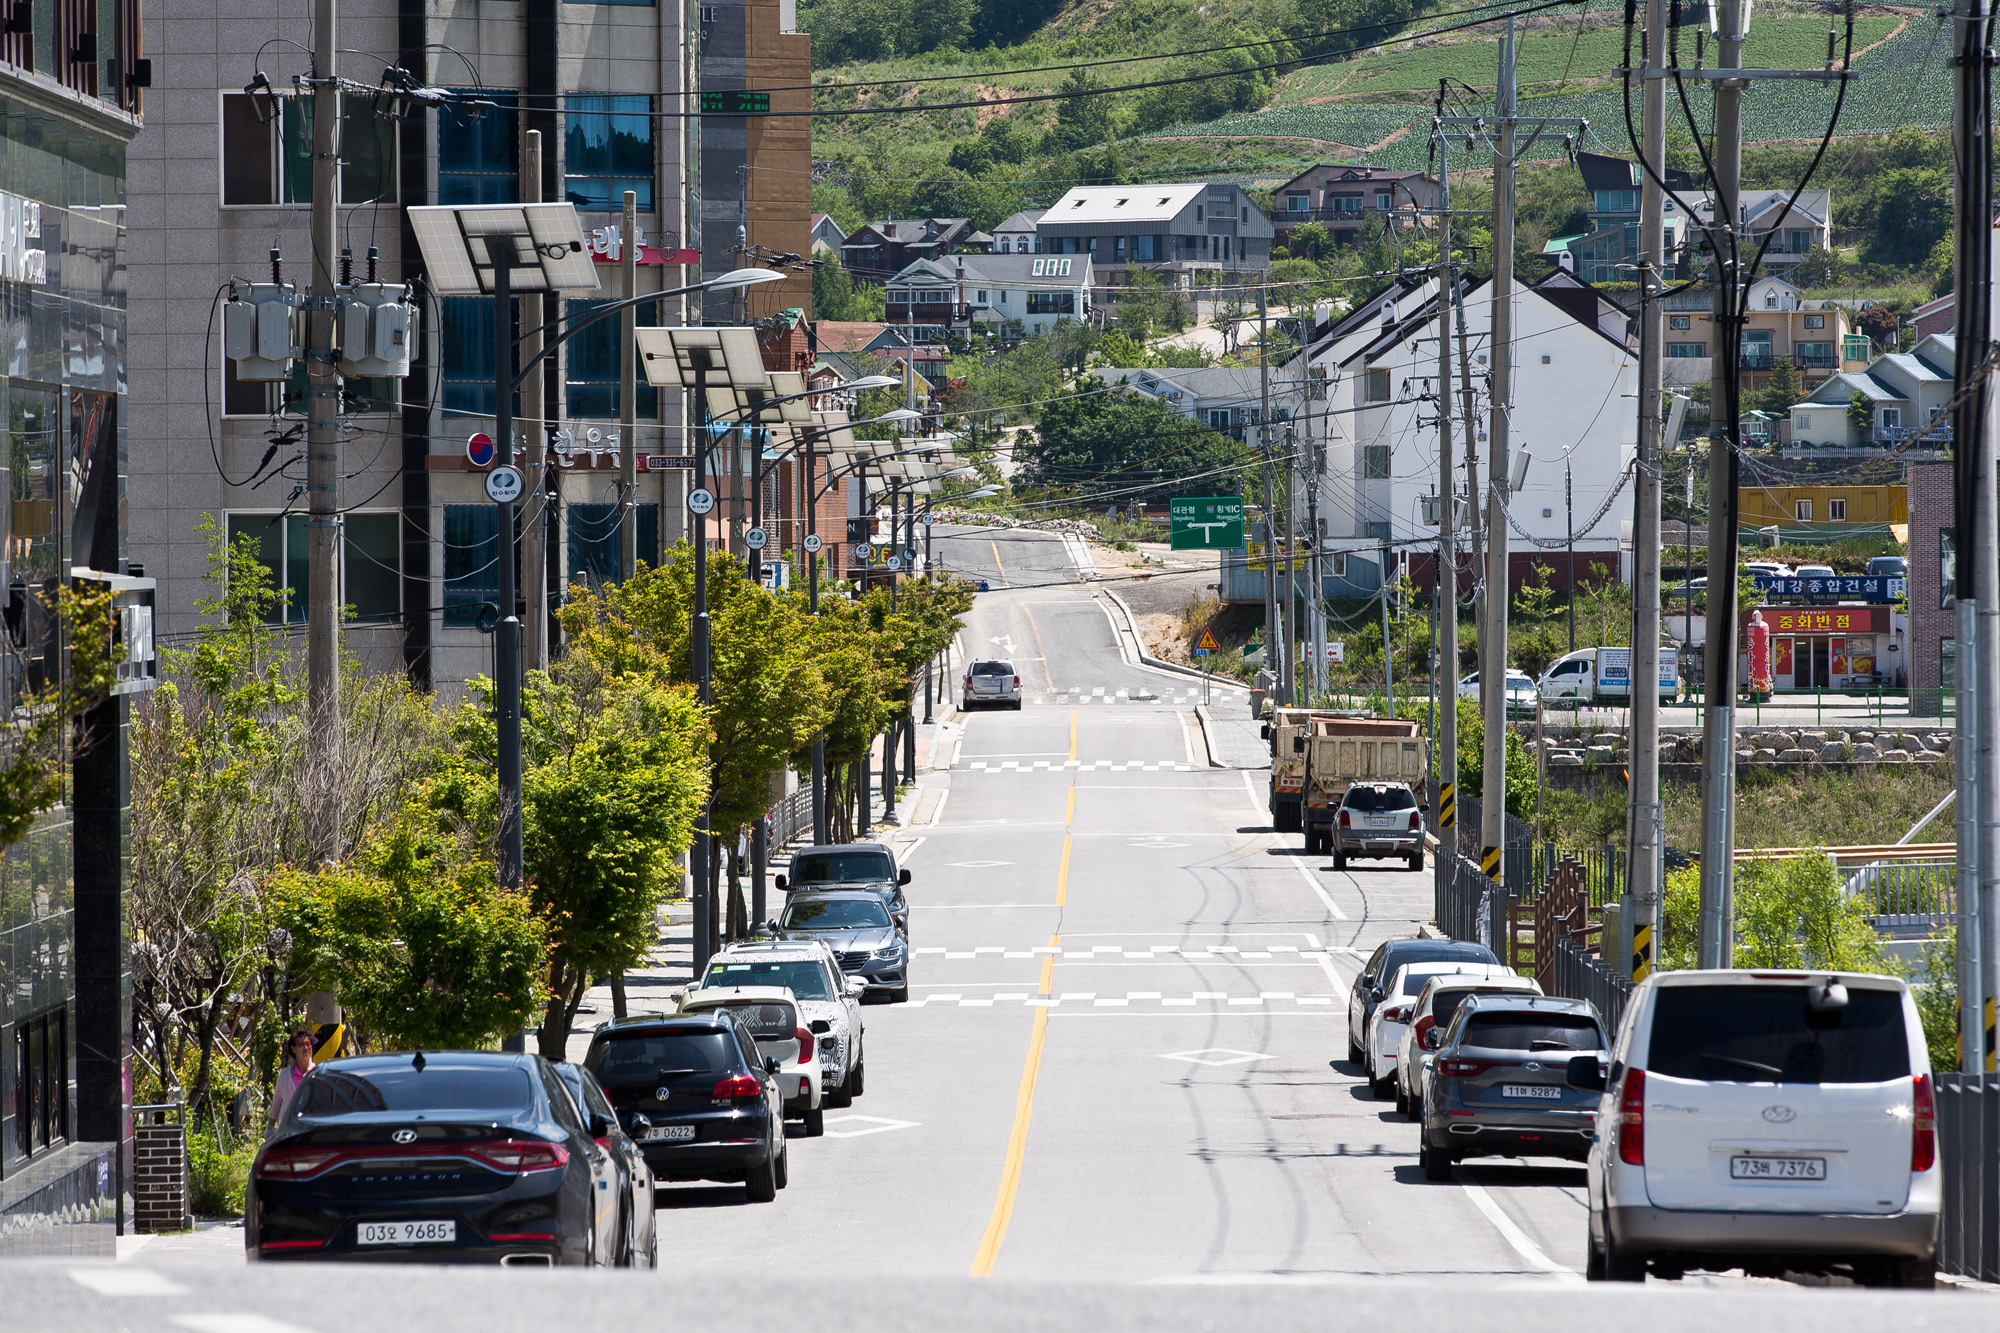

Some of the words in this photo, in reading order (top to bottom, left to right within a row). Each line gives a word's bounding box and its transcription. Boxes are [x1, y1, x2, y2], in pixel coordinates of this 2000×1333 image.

[651, 458, 696, 467] 033-335-6577
[1173, 506, 1195, 514] 대관령
[1779, 614, 1851, 629] 중화반점
[1531, 1087, 1556, 1097] 5287
[664, 1126, 690, 1138] 0622
[1776, 1160, 1817, 1177] 7376
[404, 1223, 447, 1240] 9685
